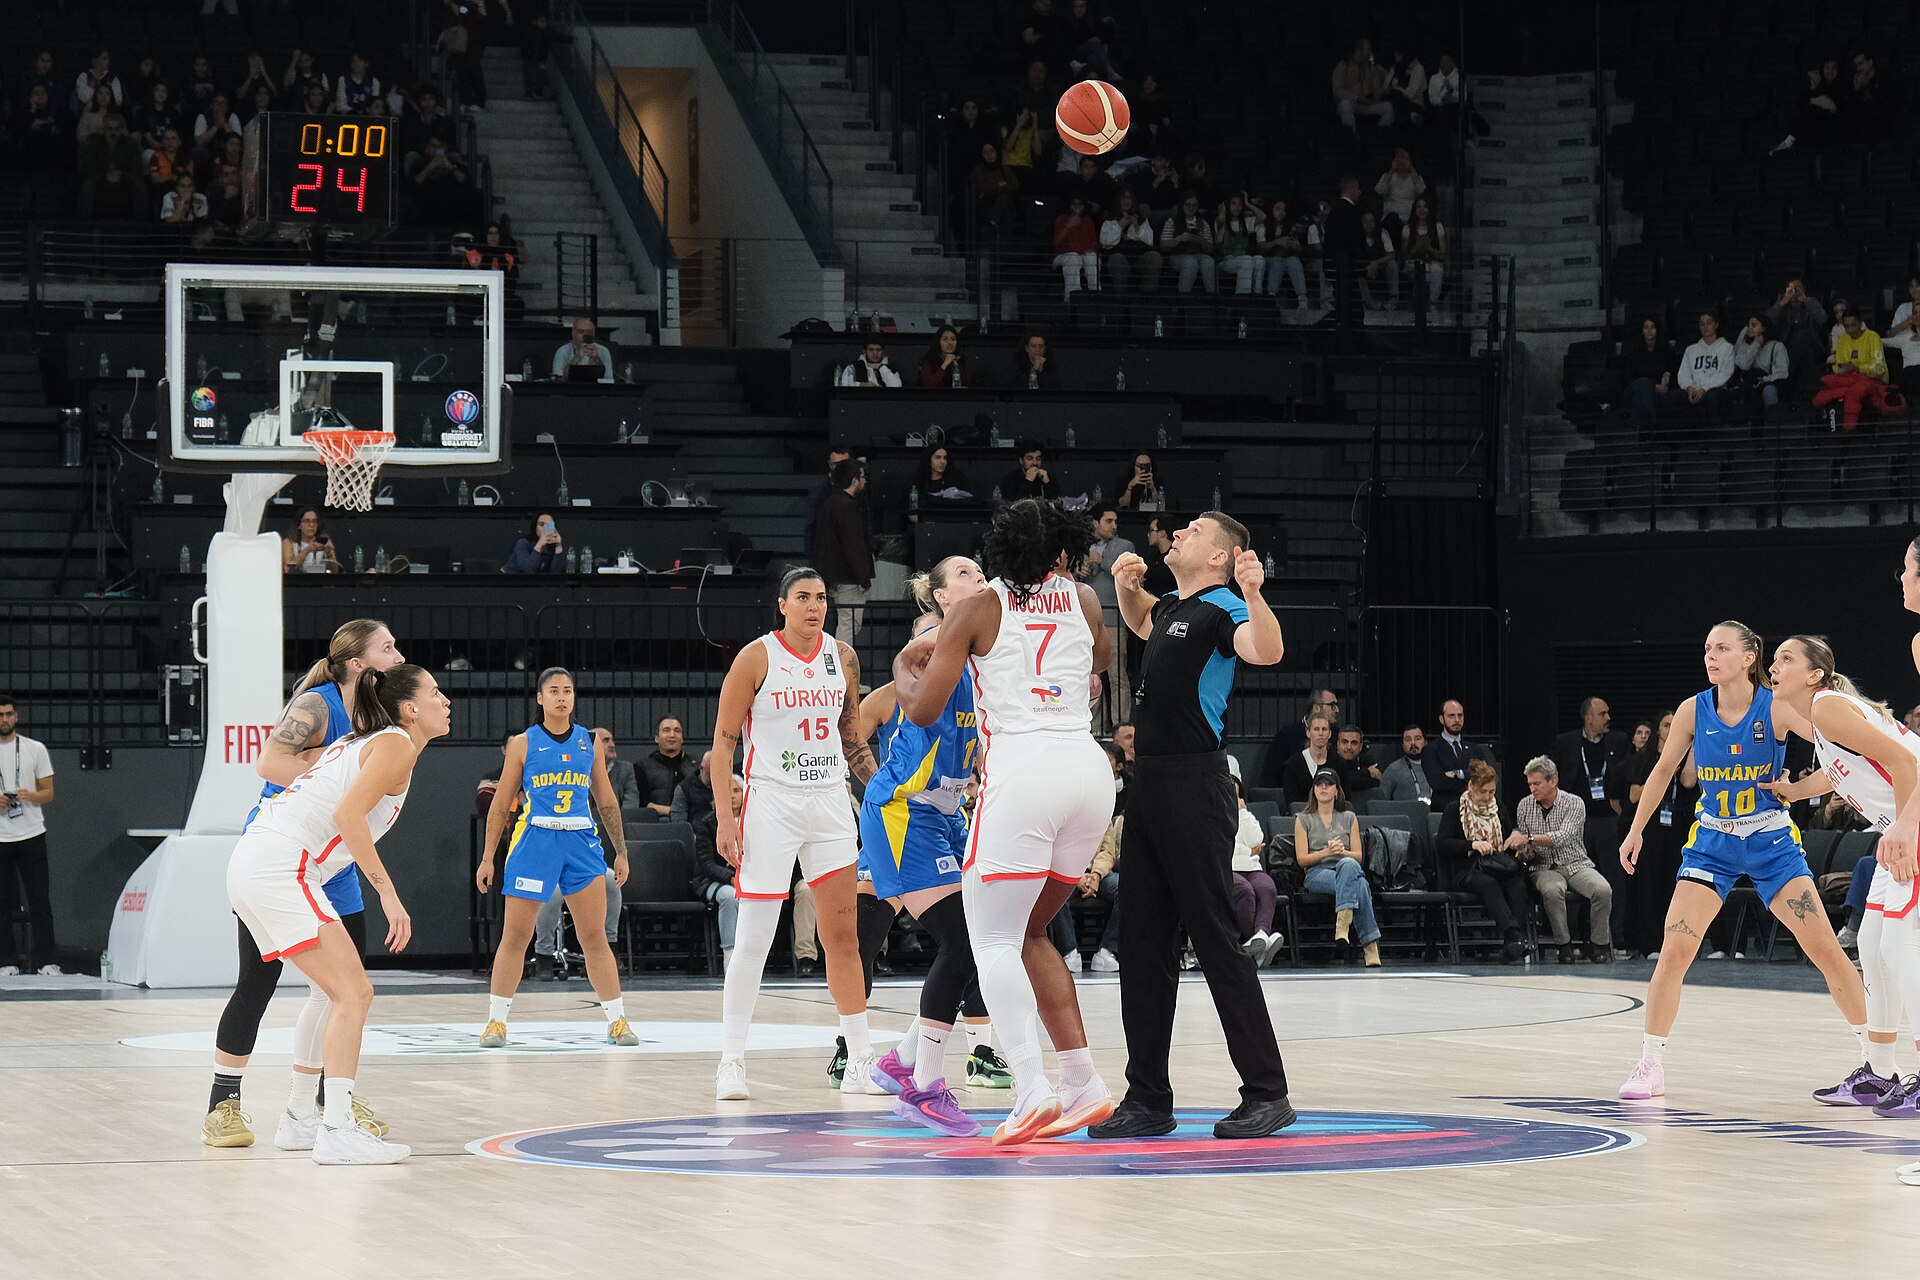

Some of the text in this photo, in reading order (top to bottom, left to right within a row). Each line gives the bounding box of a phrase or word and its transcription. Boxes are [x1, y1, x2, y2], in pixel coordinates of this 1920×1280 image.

[300, 124, 386, 157] 0:00
[290, 164, 367, 212] 24
[1694, 355, 1718, 371] USA
[193, 417, 214, 428] FIBA
[1025, 623, 1057, 676] 7
[771, 685, 843, 710] TÜRKİYE
[797, 717, 829, 741] 15
[224, 725, 275, 764] FIAT
[797, 753, 839, 768] Garanti
[1697, 763, 1773, 781] ROMÂNIA
[531, 770, 592, 788] ROMÂNIA
[799, 769, 831, 781] BBVA
[554, 790, 573, 813] 3
[1716, 787, 1755, 817] 10
